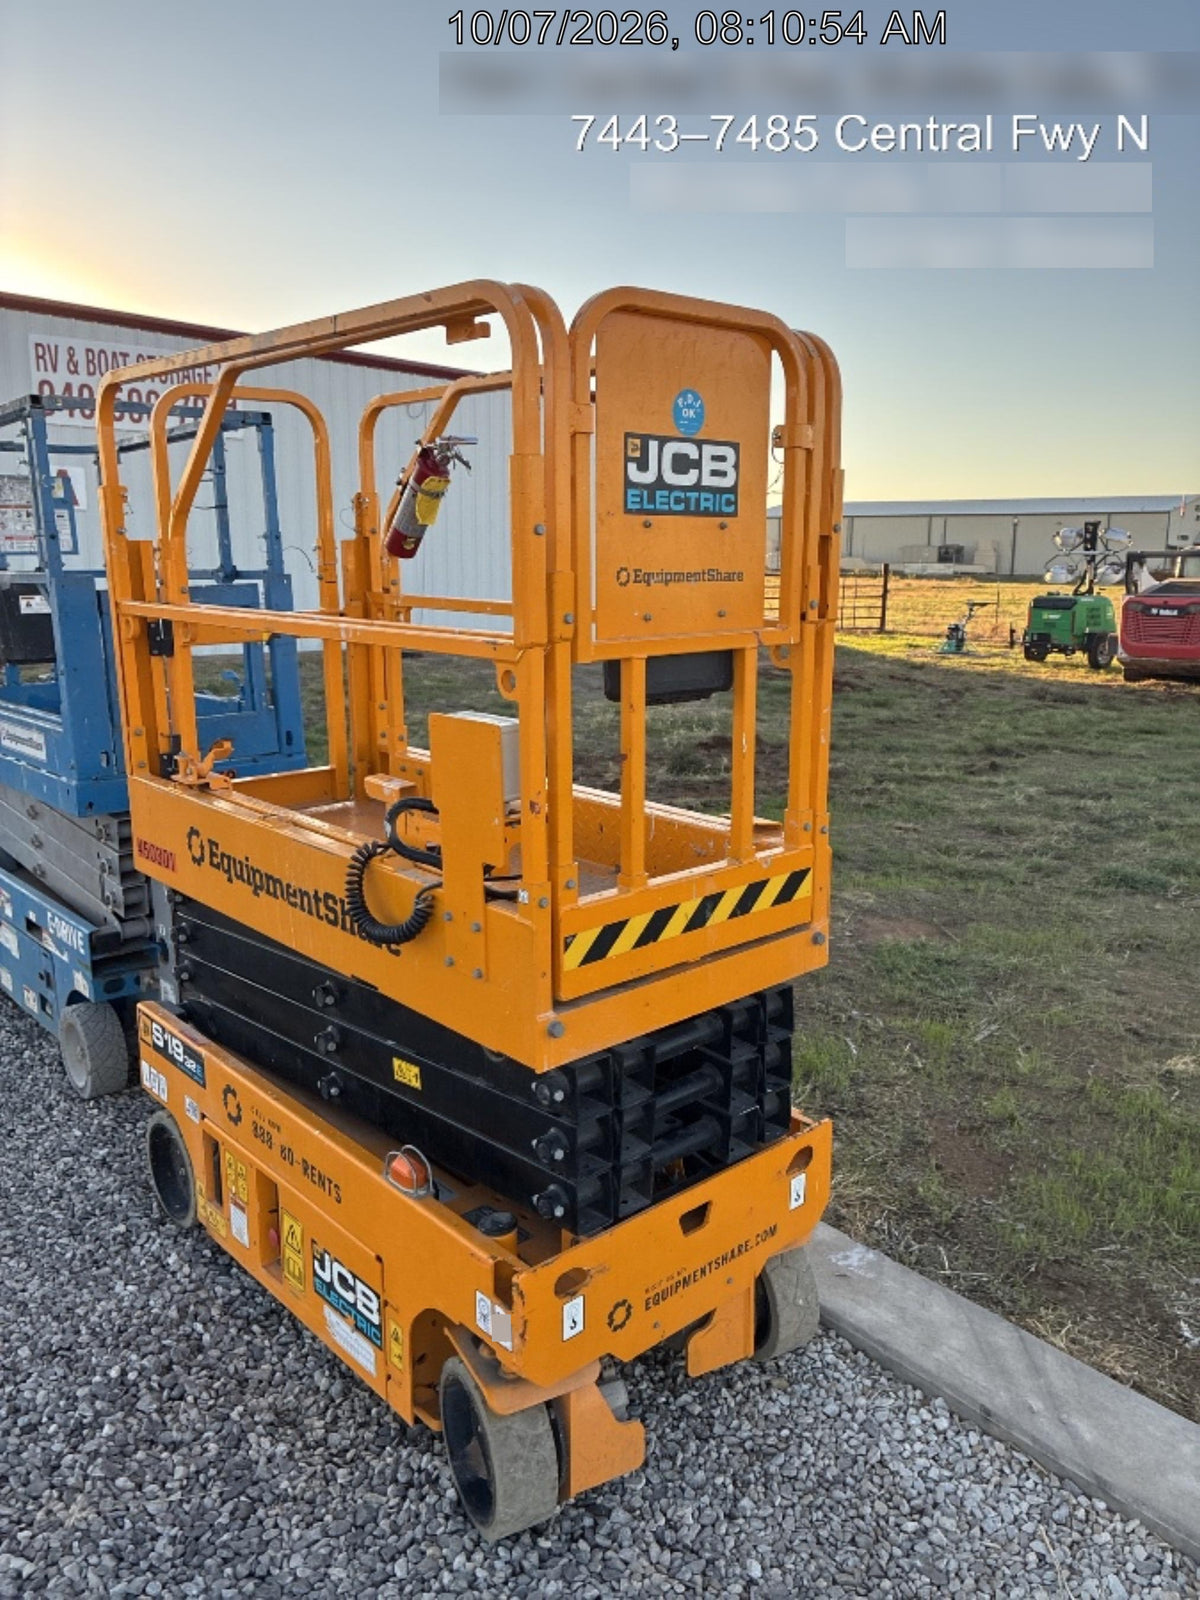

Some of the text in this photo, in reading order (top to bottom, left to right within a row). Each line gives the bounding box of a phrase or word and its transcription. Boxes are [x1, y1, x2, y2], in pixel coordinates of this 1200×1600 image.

[34, 342, 59, 374] RV
[66, 345, 80, 376] &
[627, 439, 737, 488] JCB
[627, 488, 736, 513] ELECTRIC
[633, 568, 744, 587] EquipmentShare
[208, 838, 402, 957] EquipmentSh
[314, 1252, 380, 1326] JCB
